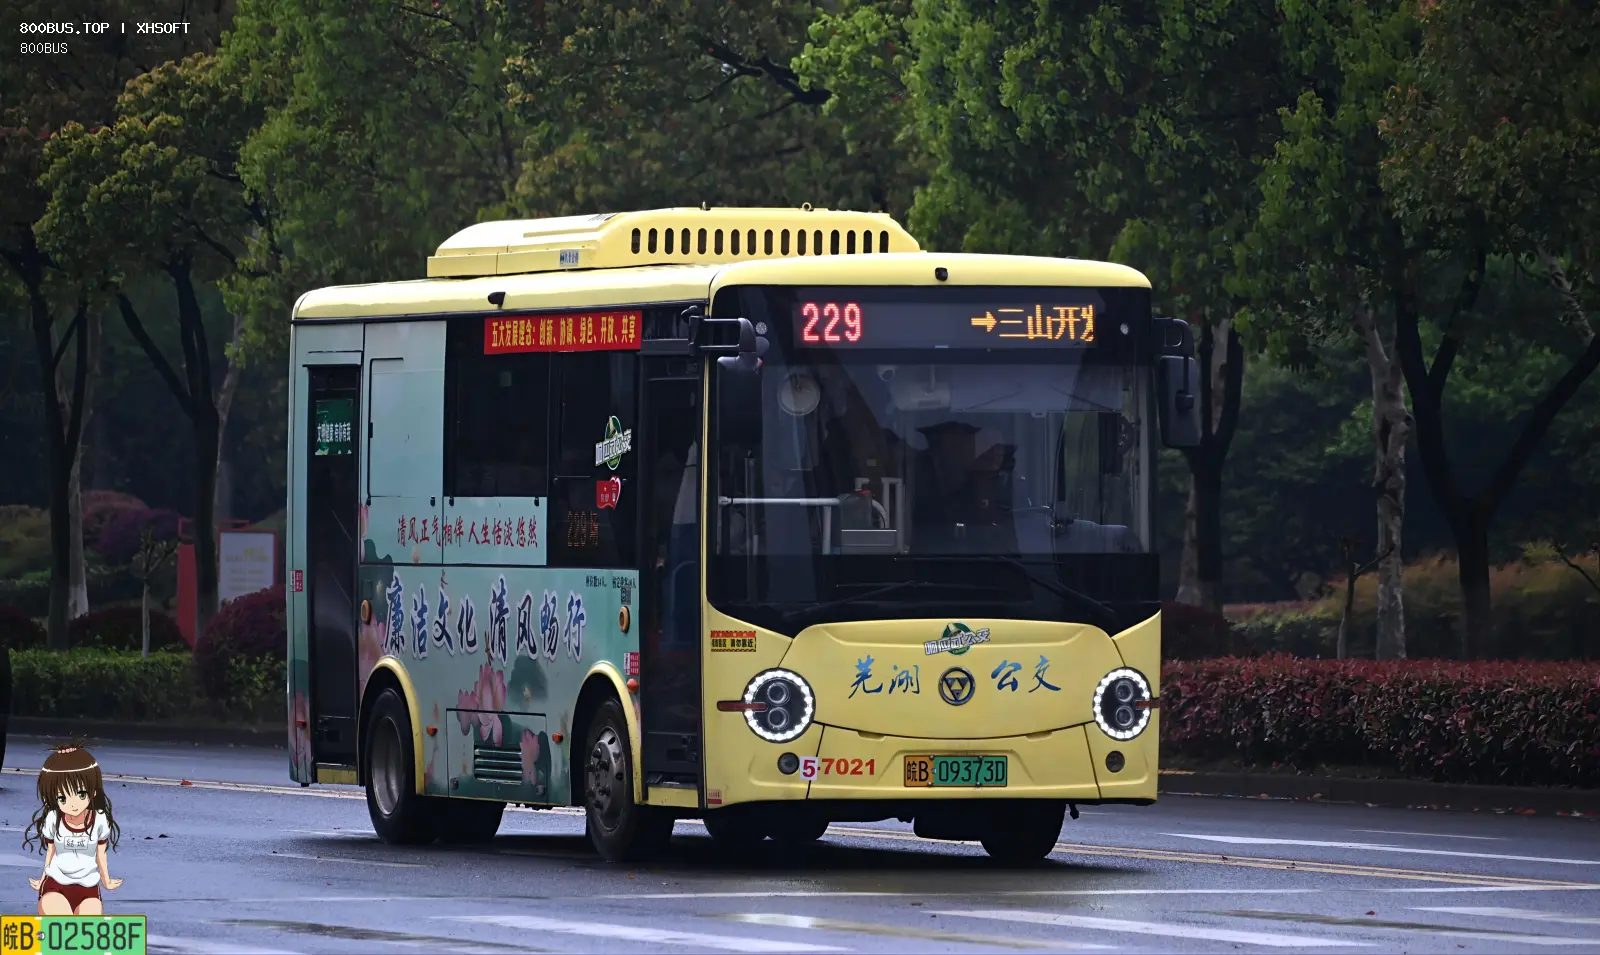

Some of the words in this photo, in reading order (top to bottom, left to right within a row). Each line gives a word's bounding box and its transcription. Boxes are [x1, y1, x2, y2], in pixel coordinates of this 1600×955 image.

[803, 303, 861, 341] 229
[848, 654, 920, 699] 芜湖
[990, 654, 1062, 694] 公交
